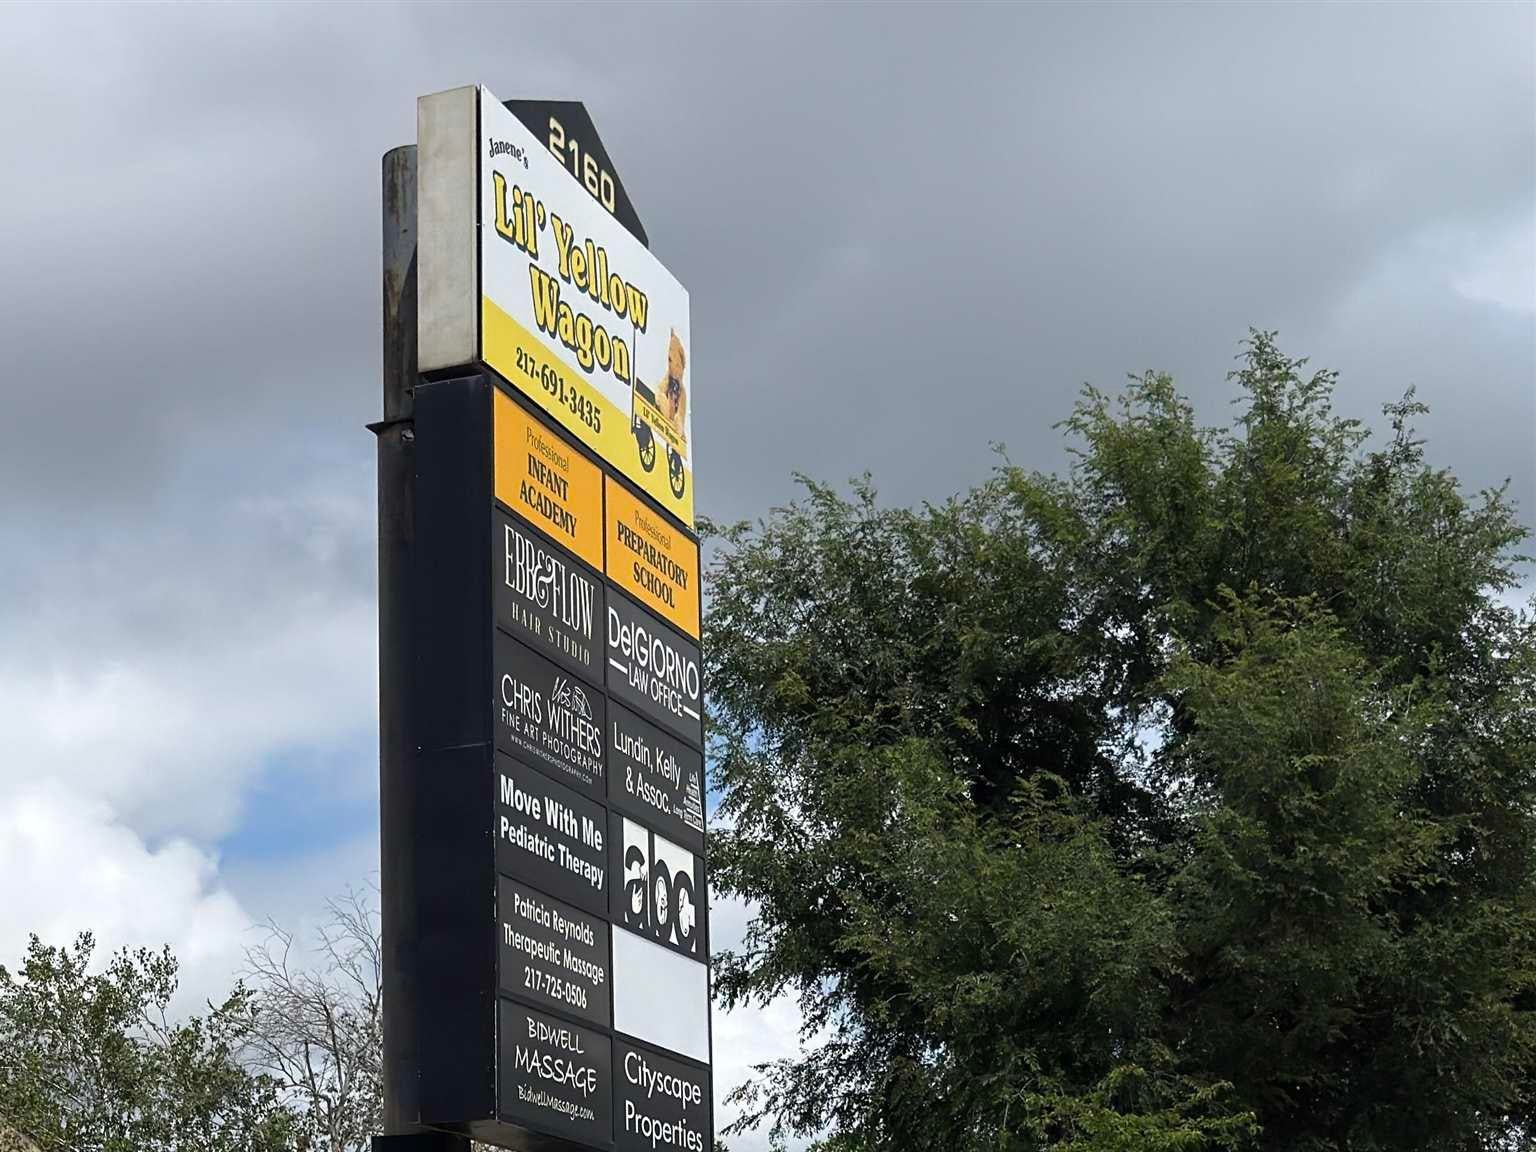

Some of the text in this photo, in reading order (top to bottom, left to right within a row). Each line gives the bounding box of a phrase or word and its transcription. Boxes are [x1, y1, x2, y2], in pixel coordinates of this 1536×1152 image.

[489, 137, 528, 169] Janene's
[549, 116, 614, 213] 2160
[493, 170, 648, 334] Lil' Yellow
[529, 262, 631, 386] Wagon
[516, 347, 601, 433] 217-691-3435
[526, 426, 569, 473] Professional
[527, 452, 569, 501] INFANT
[519, 479, 577, 538] ACADEMY
[634, 510, 672, 551] Professional
[617, 520, 688, 590] PREPARATORY
[633, 561, 675, 609] SCHOOL
[512, 602, 590, 665] HAIR STUDIO
[608, 606, 699, 700] DelGIORNO
[502, 673, 542, 724] CHRIS
[547, 699, 601, 758] WITHERS
[629, 662, 682, 717] LAW OFFICE
[501, 708, 603, 777] FINE ART PHOTOGRAPHY
[614, 721, 681, 790] Lundin, Kelly
[626, 766, 634, 794] &
[500, 774, 603, 851] Move With Me
[500, 815, 603, 890] Pediatric Therapy
[514, 893, 594, 946] Patricia Reynolds
[504, 923, 604, 985] Therapeutic Massage
[524, 966, 587, 1009] 217-725-0506
[526, 1016, 584, 1054] BIDWELL
[515, 1045, 597, 1098] MASSAGE
[624, 1051, 701, 1110] Cityscape
[625, 1099, 703, 1152] Properties
